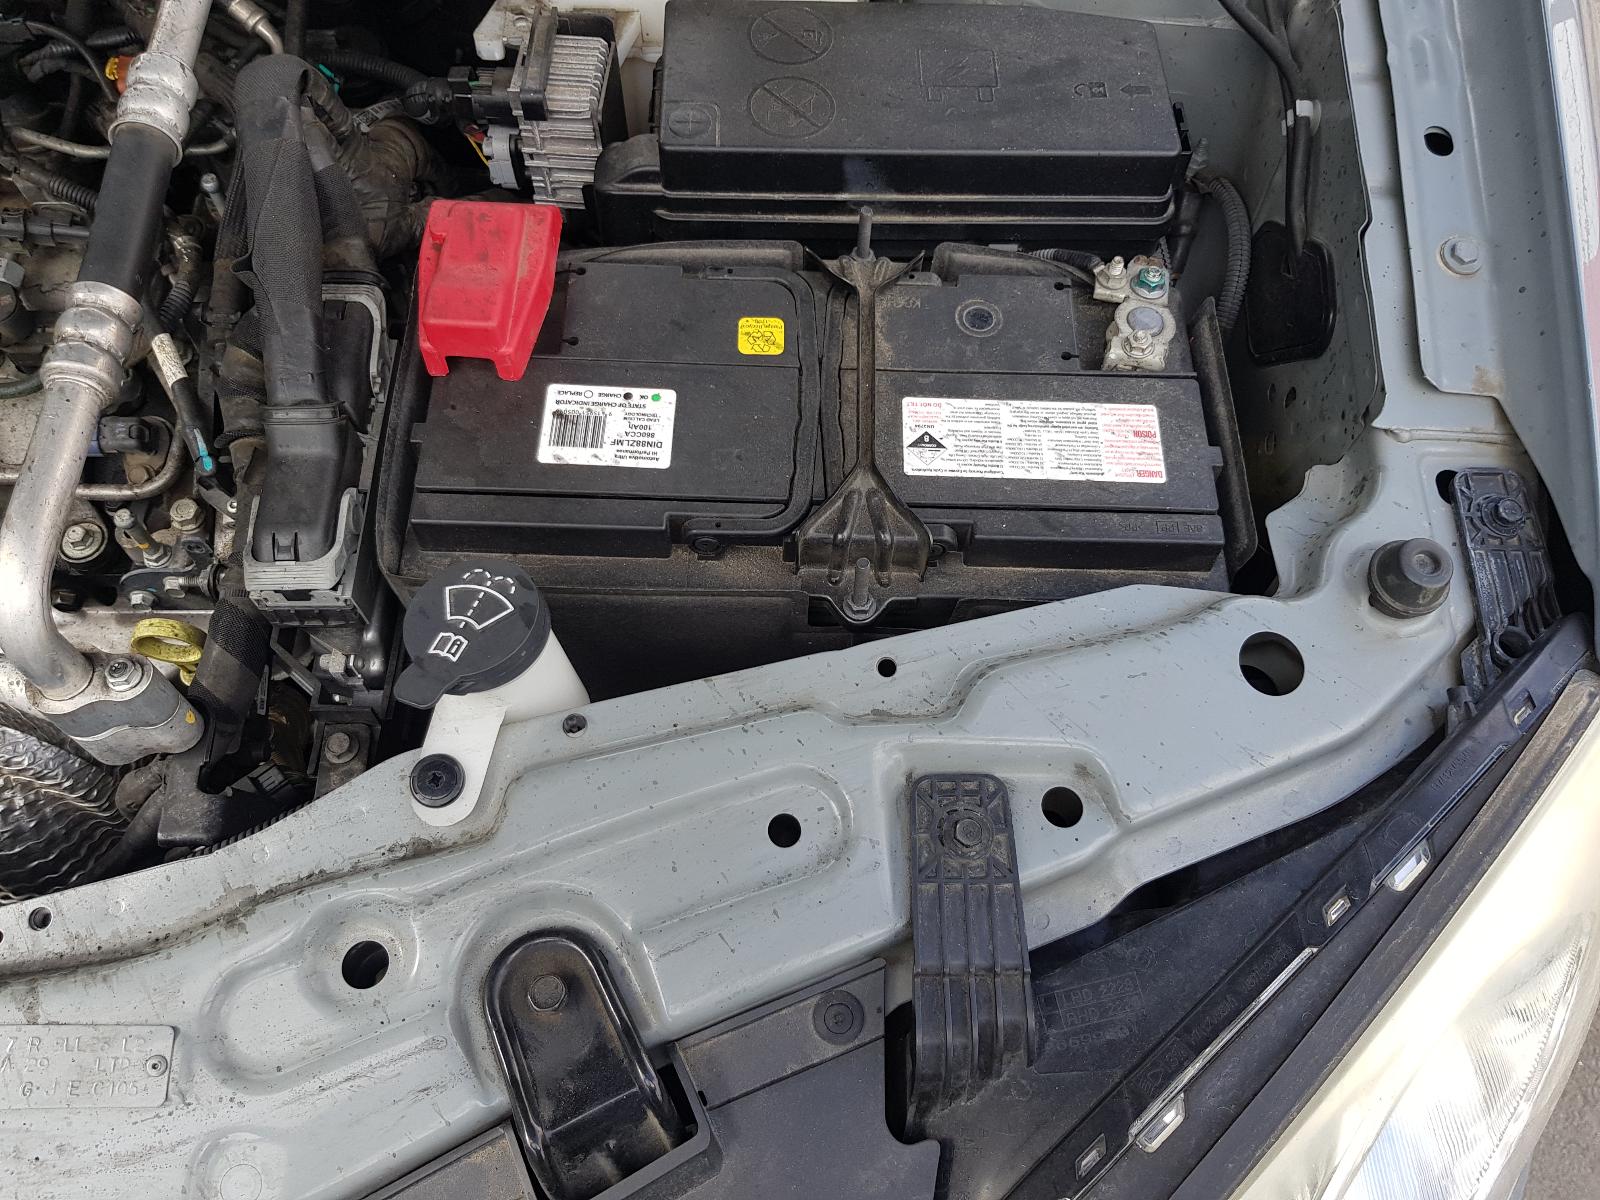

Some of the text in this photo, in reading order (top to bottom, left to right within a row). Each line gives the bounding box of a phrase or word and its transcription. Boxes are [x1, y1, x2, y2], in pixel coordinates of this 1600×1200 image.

[923, 434, 929, 442] 8
[1133, 430, 1157, 438] POISON
[610, 438, 663, 448] DIN88ZLMF
[1136, 469, 1163, 478] DANGER
